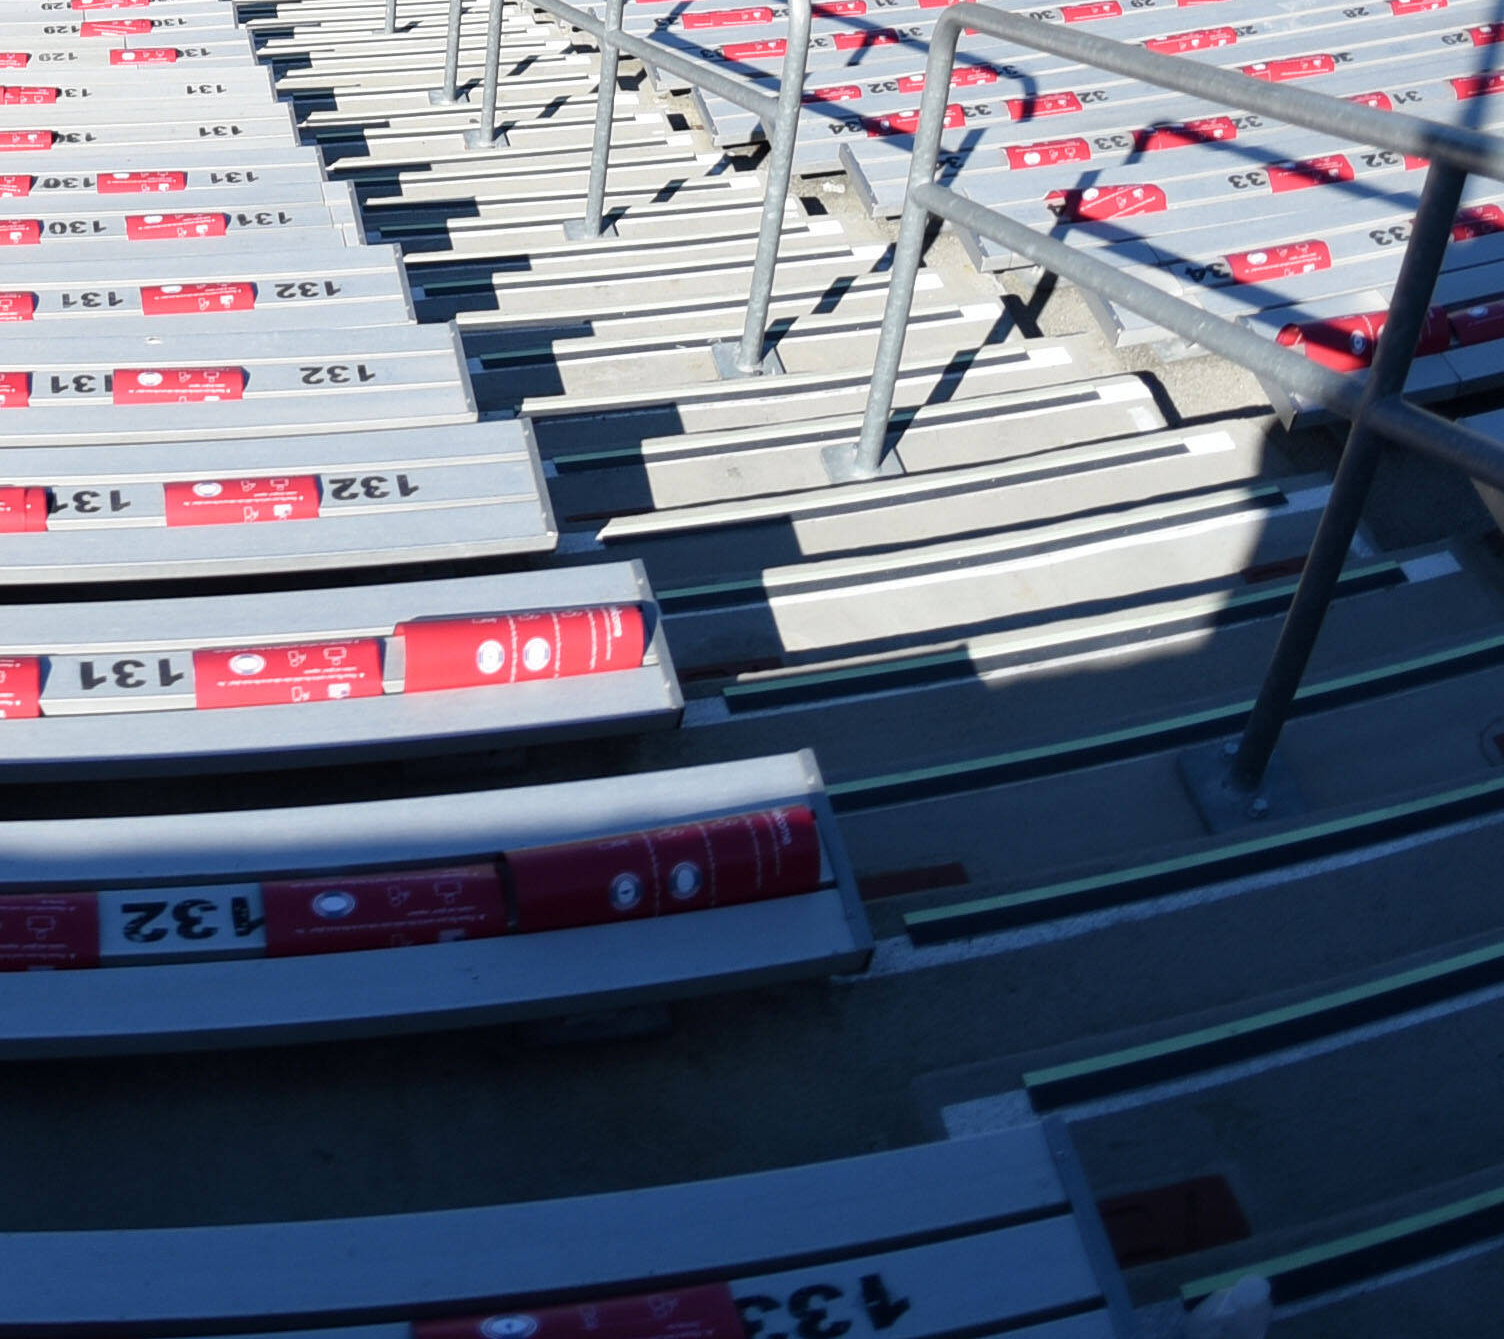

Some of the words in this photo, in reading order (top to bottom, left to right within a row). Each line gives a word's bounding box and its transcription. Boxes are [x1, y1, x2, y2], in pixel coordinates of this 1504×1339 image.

[1093, 134, 1132, 152] 33
[1362, 151, 1401, 169] 32
[210, 171, 260, 185] 131
[1228, 171, 1268, 191] 33
[49, 221, 107, 235] 130
[236, 212, 292, 227] 131
[1368, 227, 1414, 246] 33
[275, 281, 342, 298] 132
[62, 291, 125, 308] 131
[300, 364, 377, 385] 132
[329, 475, 420, 500] 132
[79, 660, 187, 692] 131
